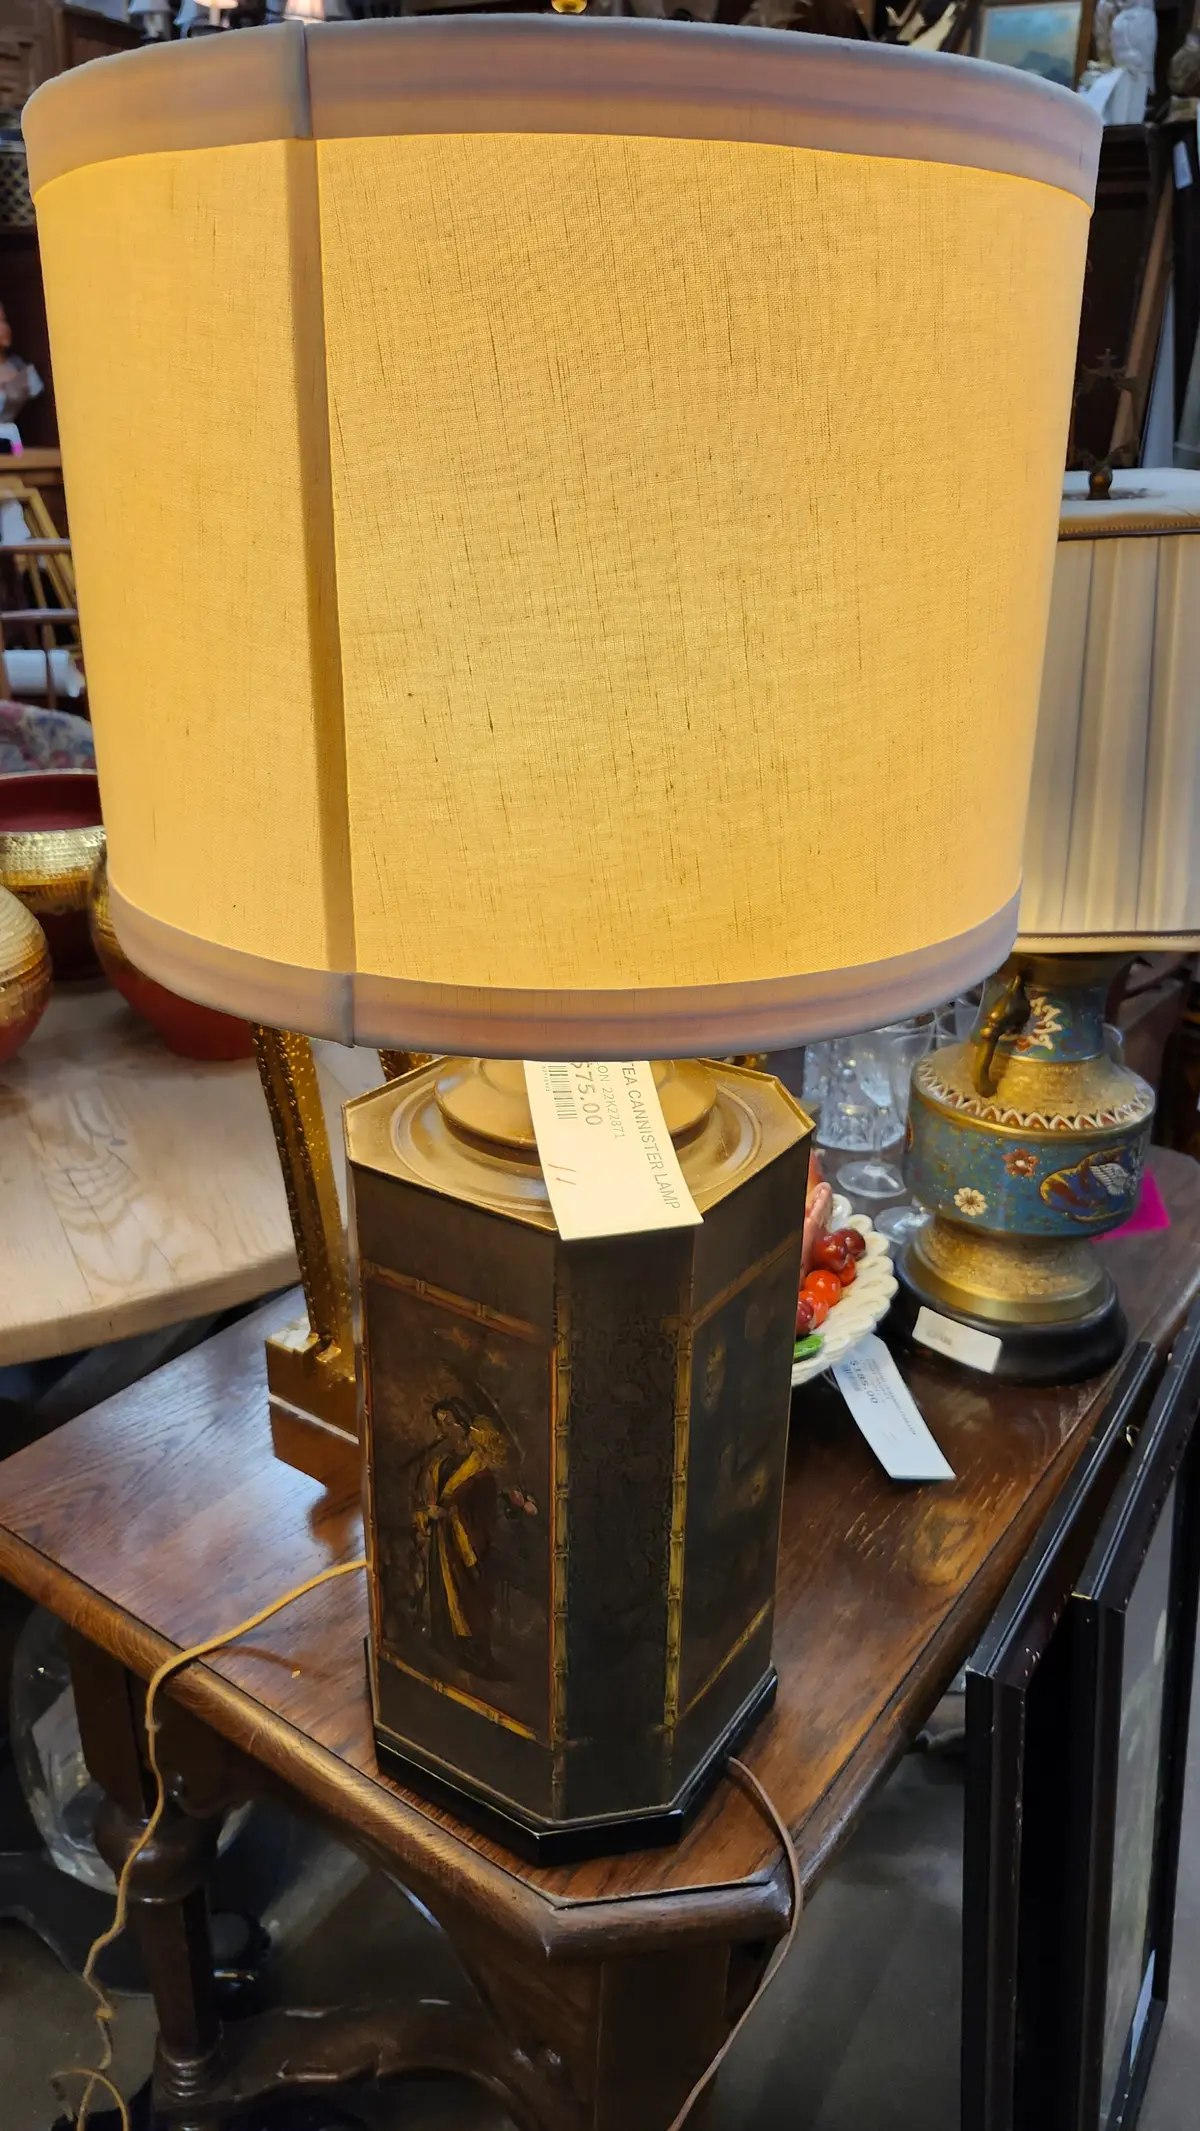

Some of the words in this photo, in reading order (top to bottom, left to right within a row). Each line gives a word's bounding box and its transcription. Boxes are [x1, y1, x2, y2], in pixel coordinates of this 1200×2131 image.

[597, 1062, 610, 1081] ON
[602, 1087, 625, 1139] 22K22871
[628, 1089, 665, 1171] CANNISTER
[654, 1173, 681, 1209] LAMP
